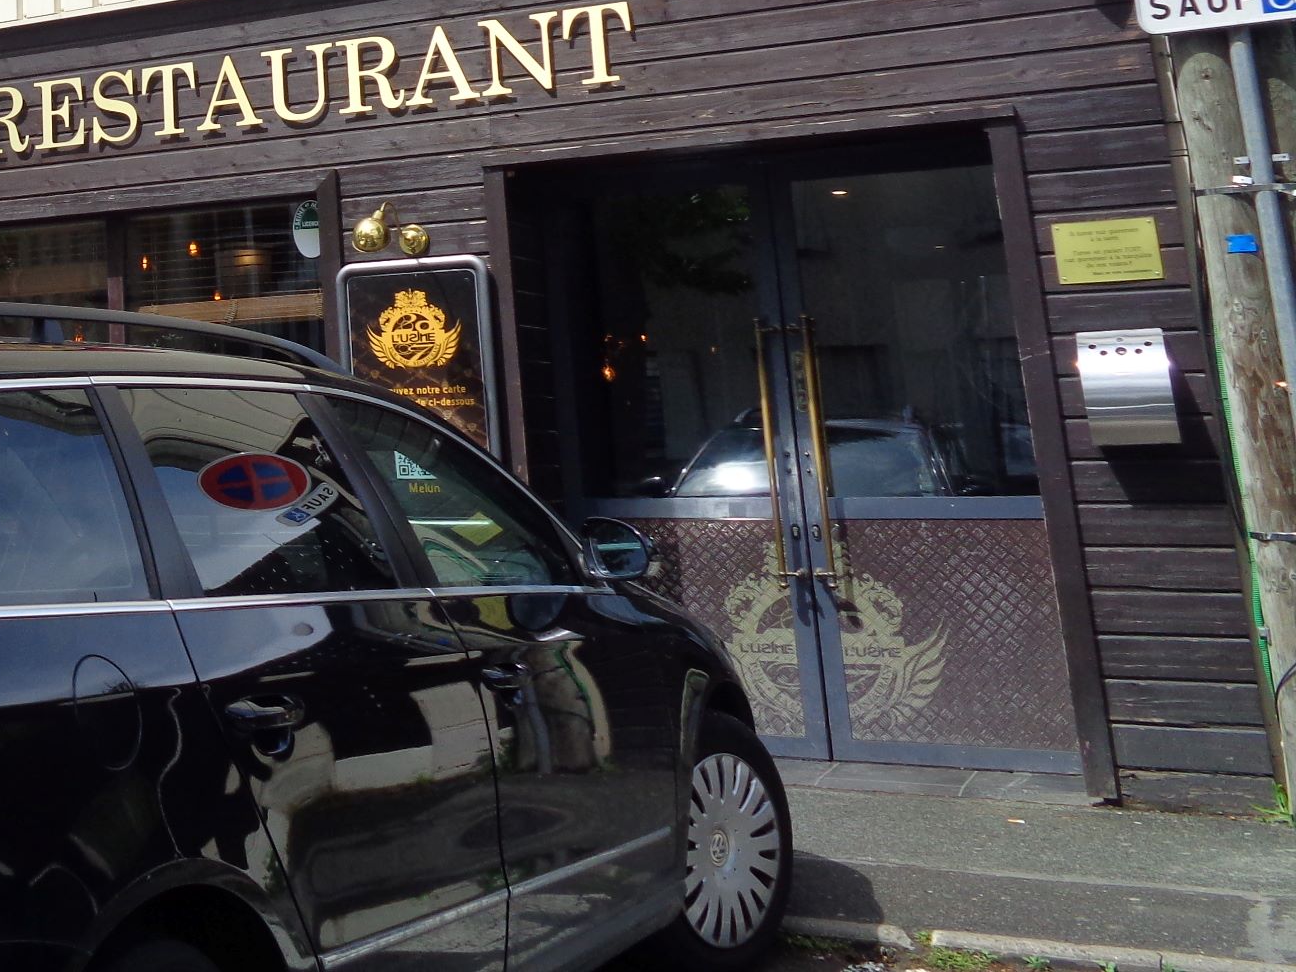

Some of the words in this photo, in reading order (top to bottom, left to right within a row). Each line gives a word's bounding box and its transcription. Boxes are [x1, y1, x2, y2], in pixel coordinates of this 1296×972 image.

[416, 385, 441, 395] notre
[442, 384, 467, 394] carte
[428, 397, 476, 407] ci-dessous
[408, 482, 441, 493] Melun
